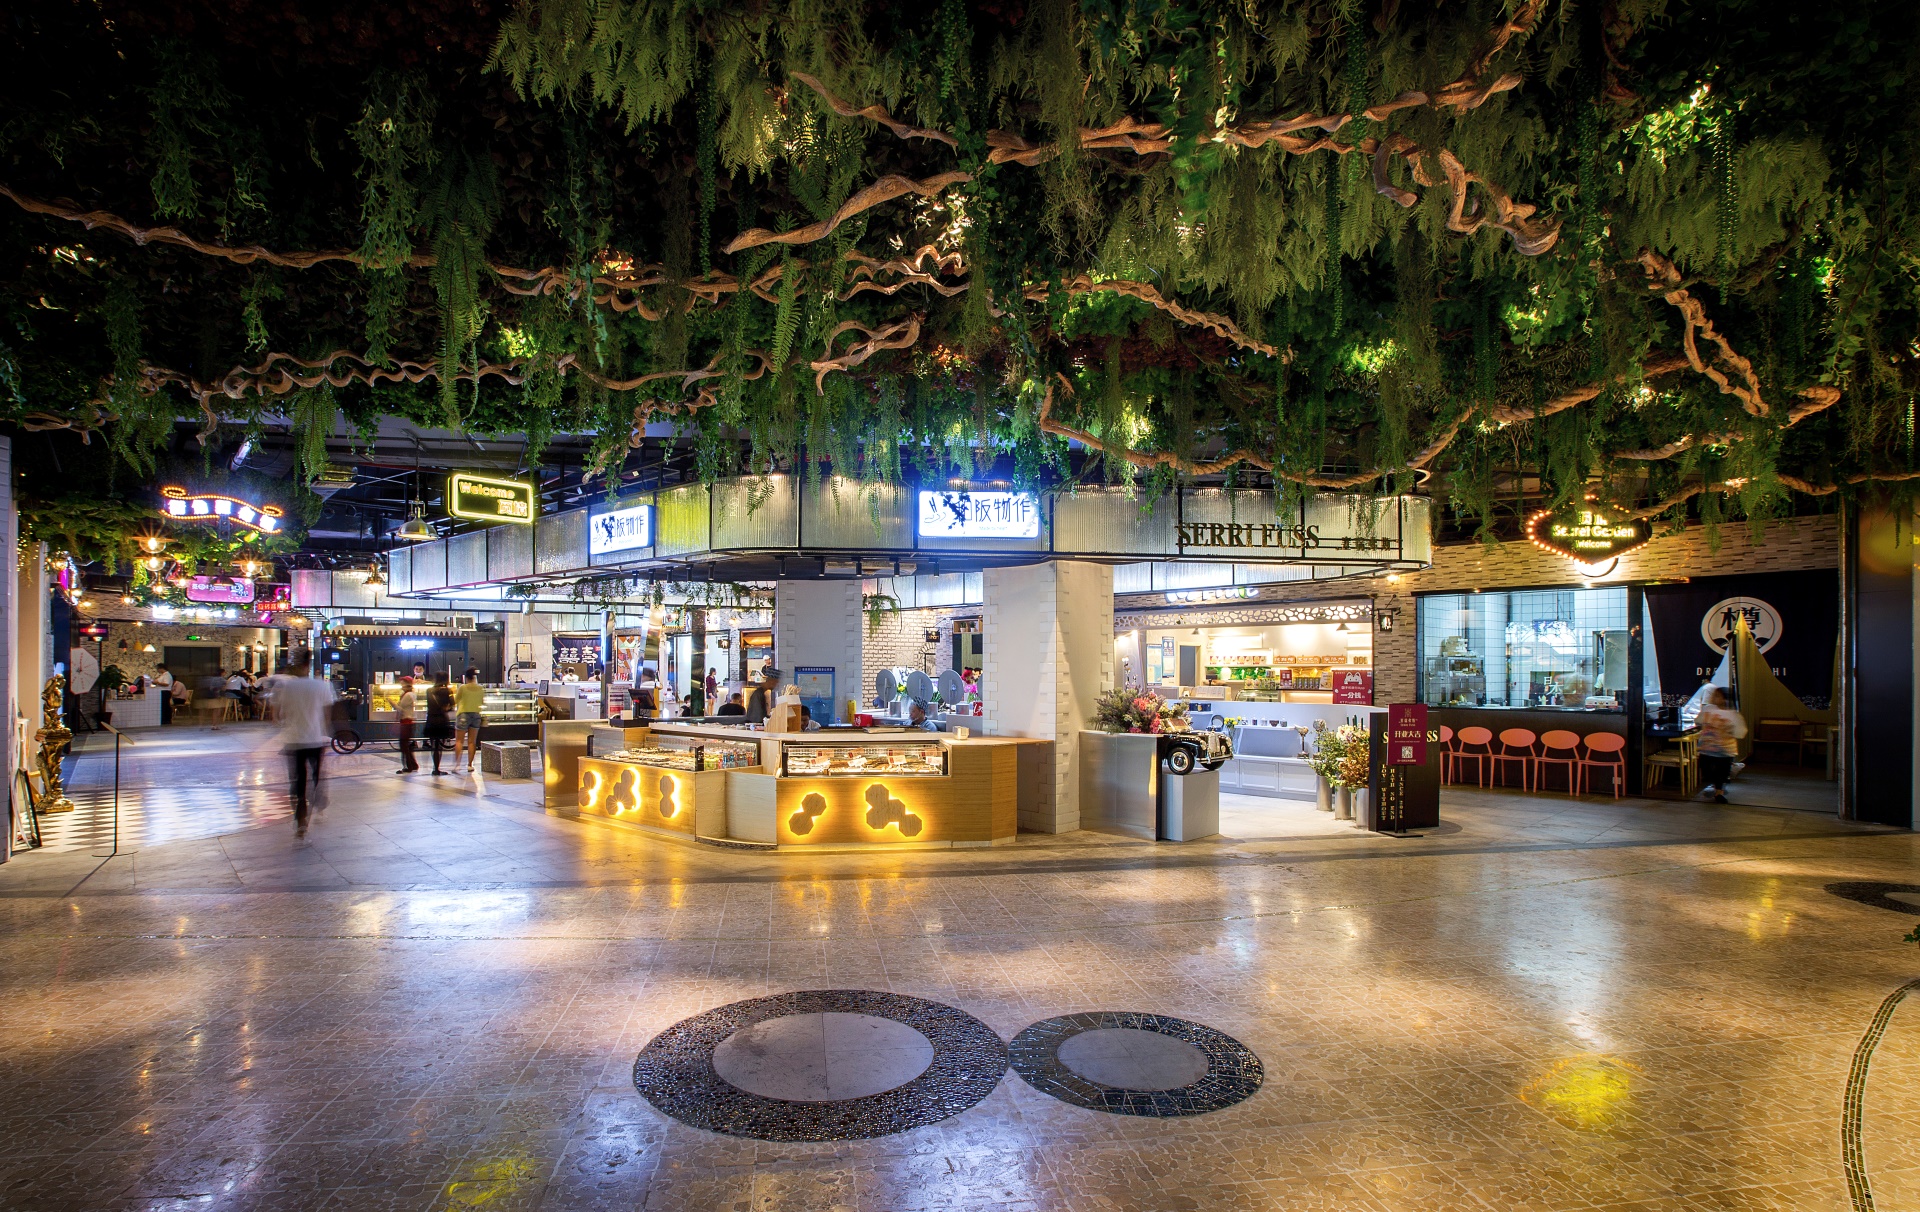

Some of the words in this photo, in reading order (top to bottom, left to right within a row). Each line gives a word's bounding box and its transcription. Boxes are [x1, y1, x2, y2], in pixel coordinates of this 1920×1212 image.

[459, 481, 516, 500] Welcome
[1175, 521, 1255, 548] SERRI
[1260, 523, 1320, 549] FUSS
[1575, 540, 1612, 548] Welcome
